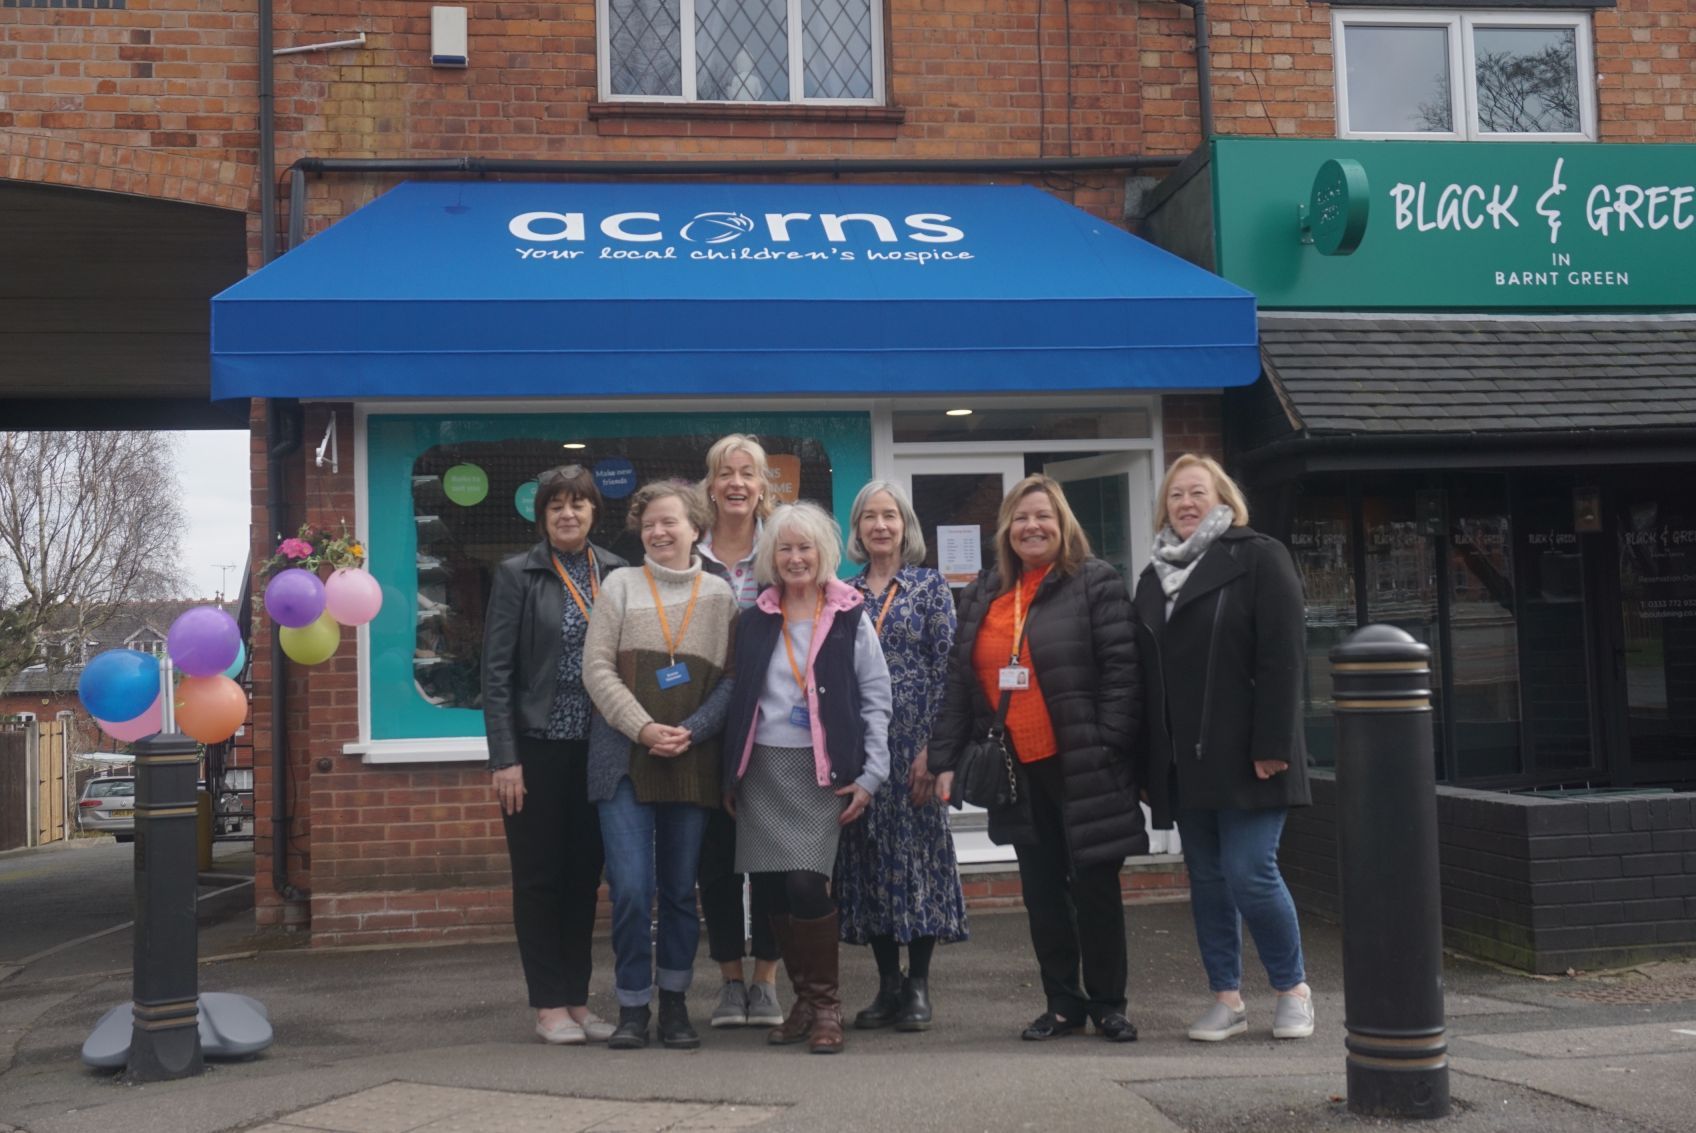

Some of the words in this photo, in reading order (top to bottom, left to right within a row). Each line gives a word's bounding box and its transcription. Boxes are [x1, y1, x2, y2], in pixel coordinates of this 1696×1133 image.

[1389, 181, 1519, 232] BLACK
[1535, 157, 1567, 244] &
[508, 211, 966, 243] acorns
[515, 246, 586, 261] Your
[599, 245, 678, 261] local
[690, 245, 856, 261] children's
[867, 246, 976, 265] hospice
[1551, 253, 1571, 266] IN
[1495, 271, 1560, 286] BARNT
[1567, 271, 1629, 286] GREEN
[595, 469, 616, 478] Make
[616, 468, 633, 477] new
[602, 477, 629, 486] friends
[1625, 531, 1657, 545] BLACK
